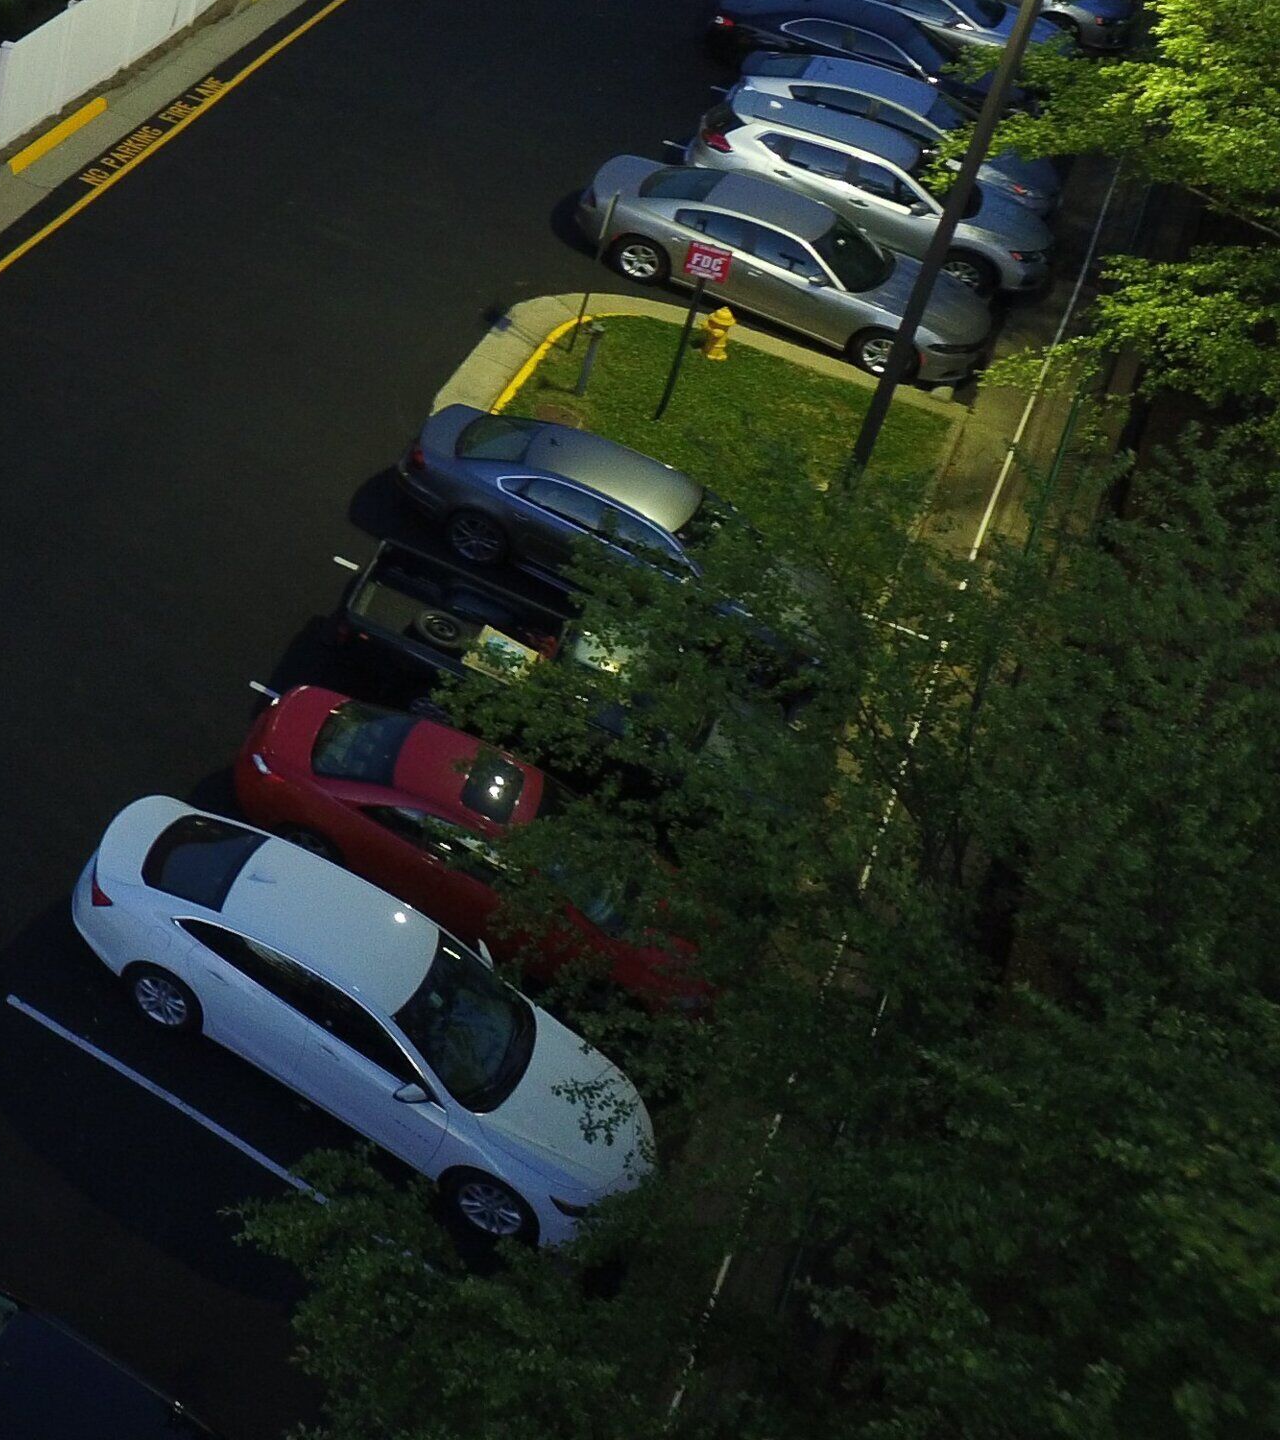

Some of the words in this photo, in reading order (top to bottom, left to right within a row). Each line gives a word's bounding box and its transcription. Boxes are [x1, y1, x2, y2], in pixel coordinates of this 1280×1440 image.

[100, 125, 164, 170] PARKING
[158, 100, 197, 124] FIRE
[691, 252, 724, 271] FDC
